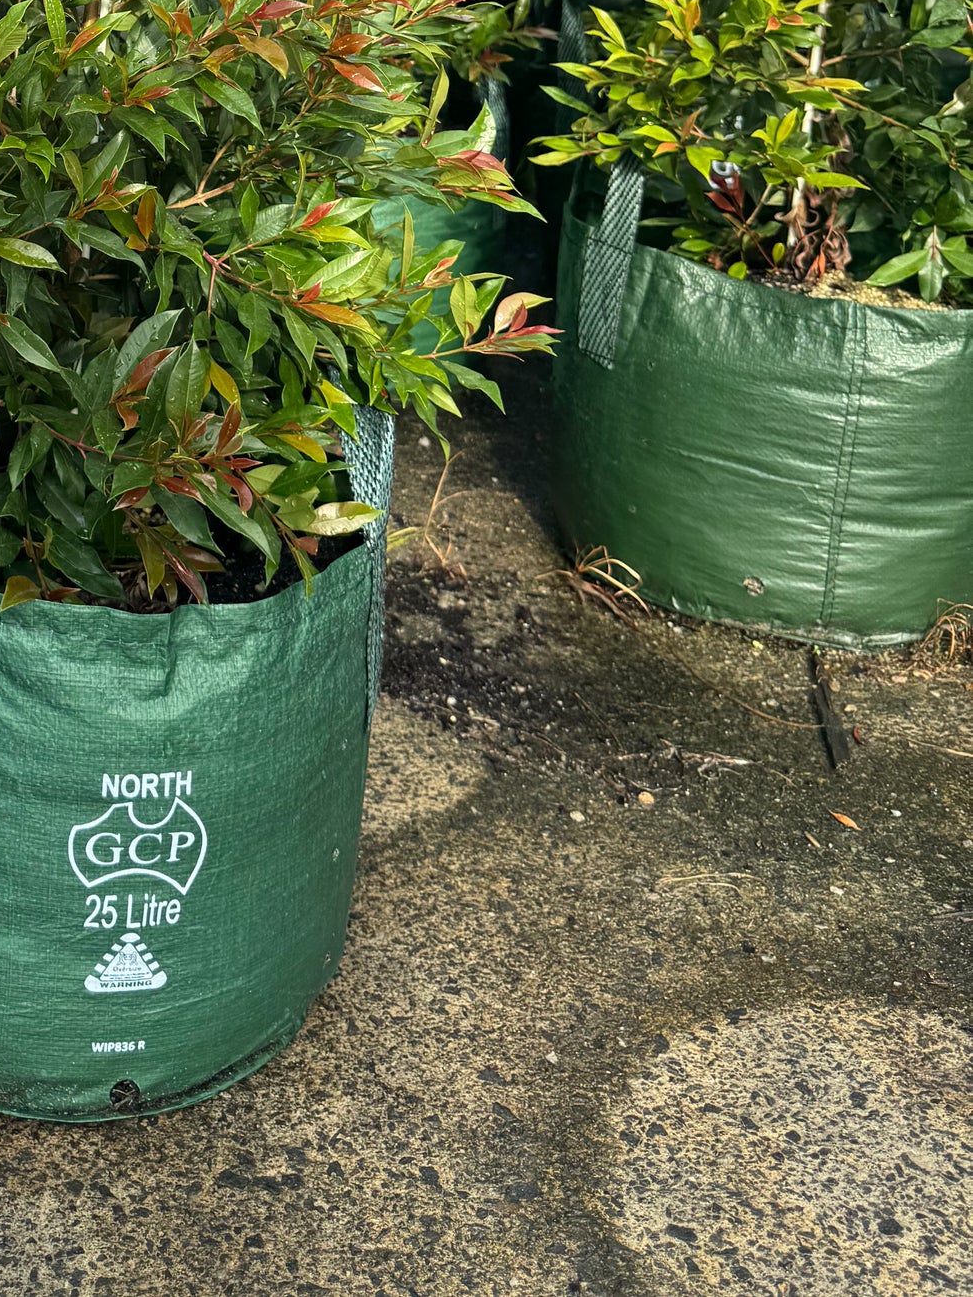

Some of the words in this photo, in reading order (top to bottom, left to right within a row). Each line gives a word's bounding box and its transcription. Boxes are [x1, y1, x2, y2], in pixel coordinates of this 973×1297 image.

[102, 770, 192, 798] NORTH
[85, 831, 195, 865] GCP
[84, 894, 118, 928] 25
[126, 893, 181, 928] Litre
[100, 980, 152, 989] WARNING
[92, 1041, 136, 1053] WIP836
[137, 1040, 146, 1050] R
